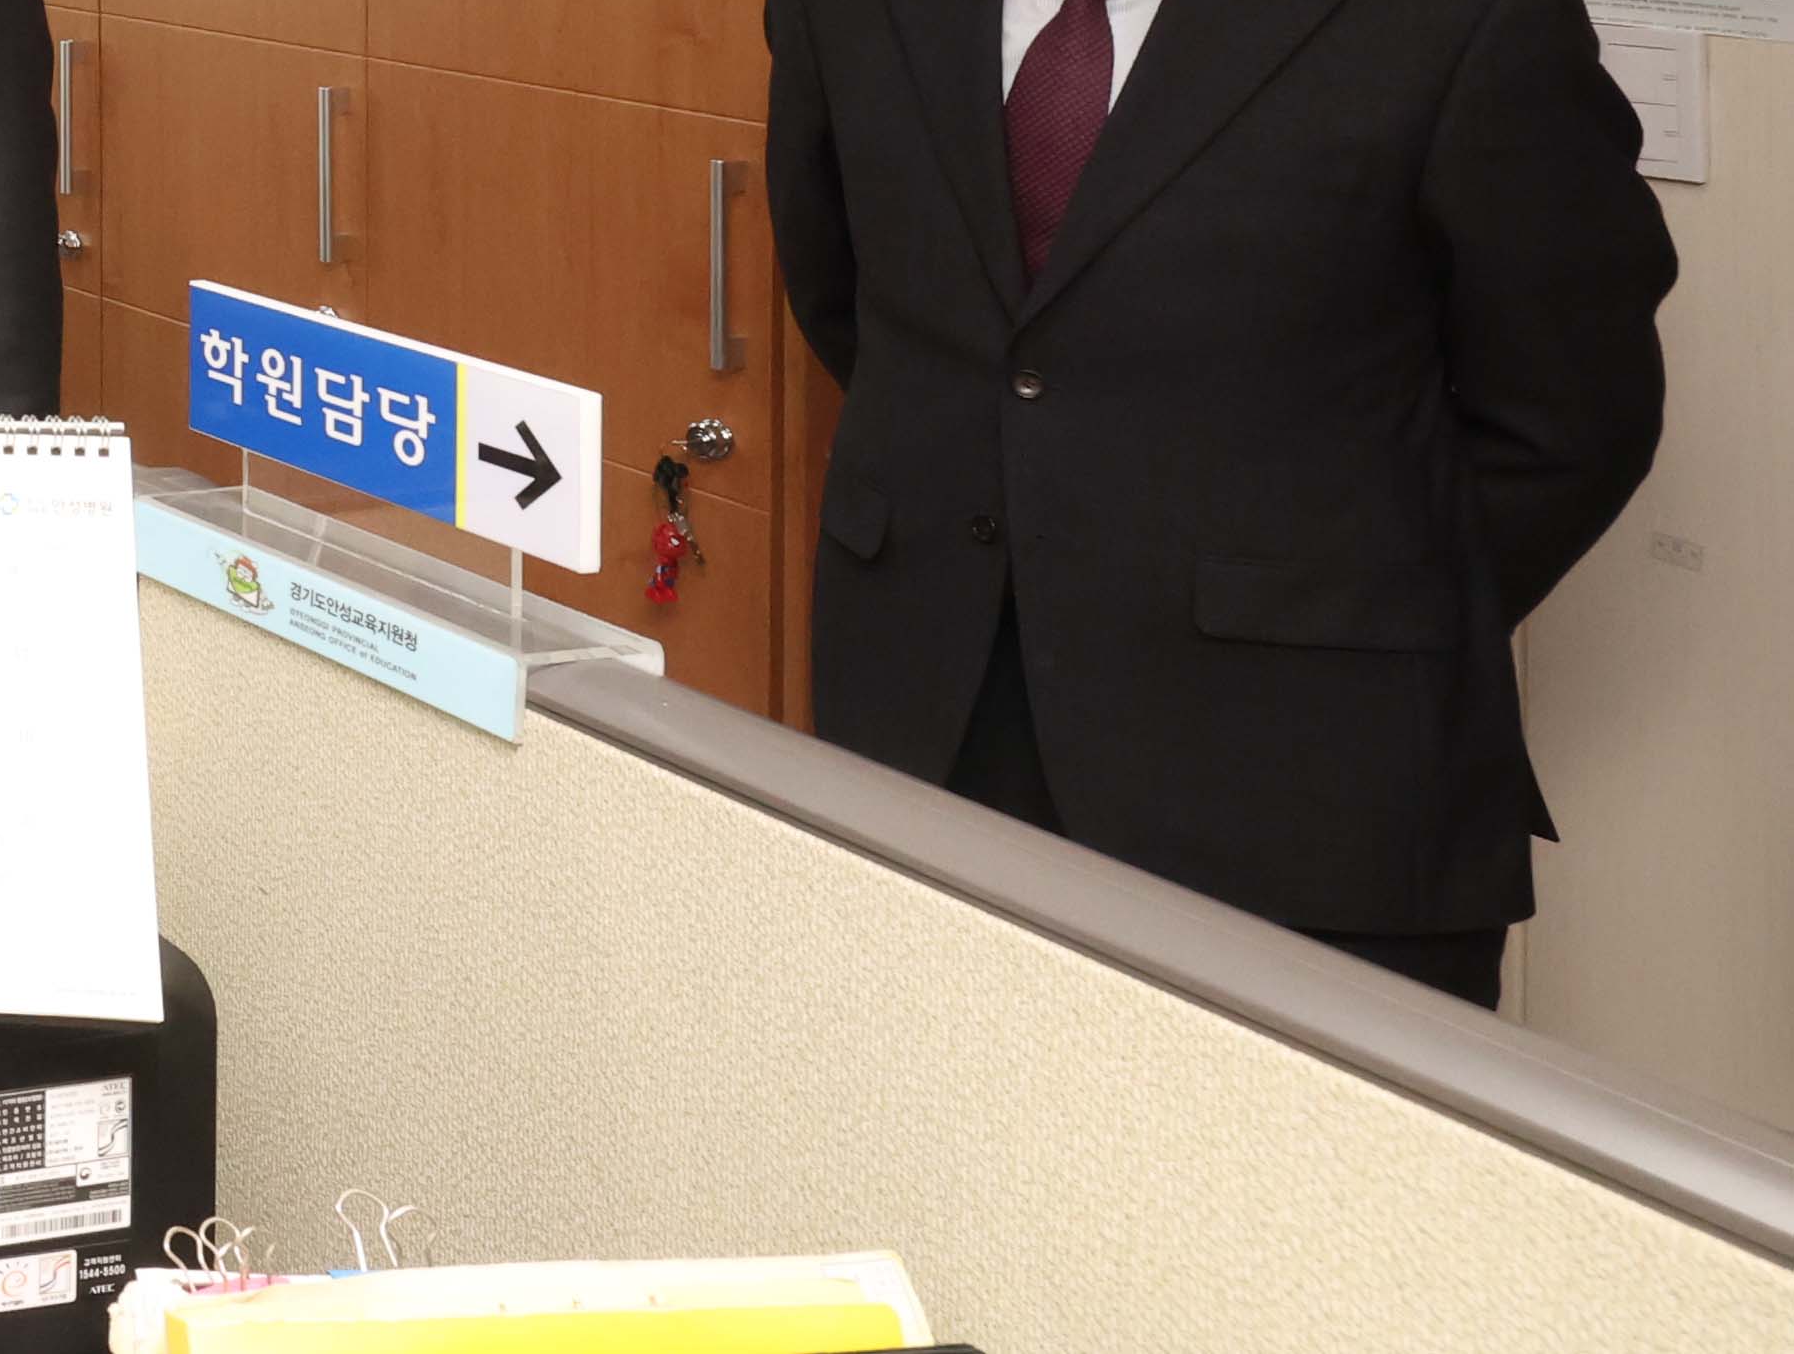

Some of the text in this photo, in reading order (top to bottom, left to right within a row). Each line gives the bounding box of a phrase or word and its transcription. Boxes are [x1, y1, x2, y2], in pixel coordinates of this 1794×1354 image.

[200, 328, 436, 467] 학원담당
[290, 581, 417, 652] 경기도안성교육지원청
[328, 636, 356, 654] OFFICE
[370, 653, 417, 681] EDUCATION
[79, 1264, 126, 1280] 1544-5500
[89, 1283, 115, 1295] ATEC
